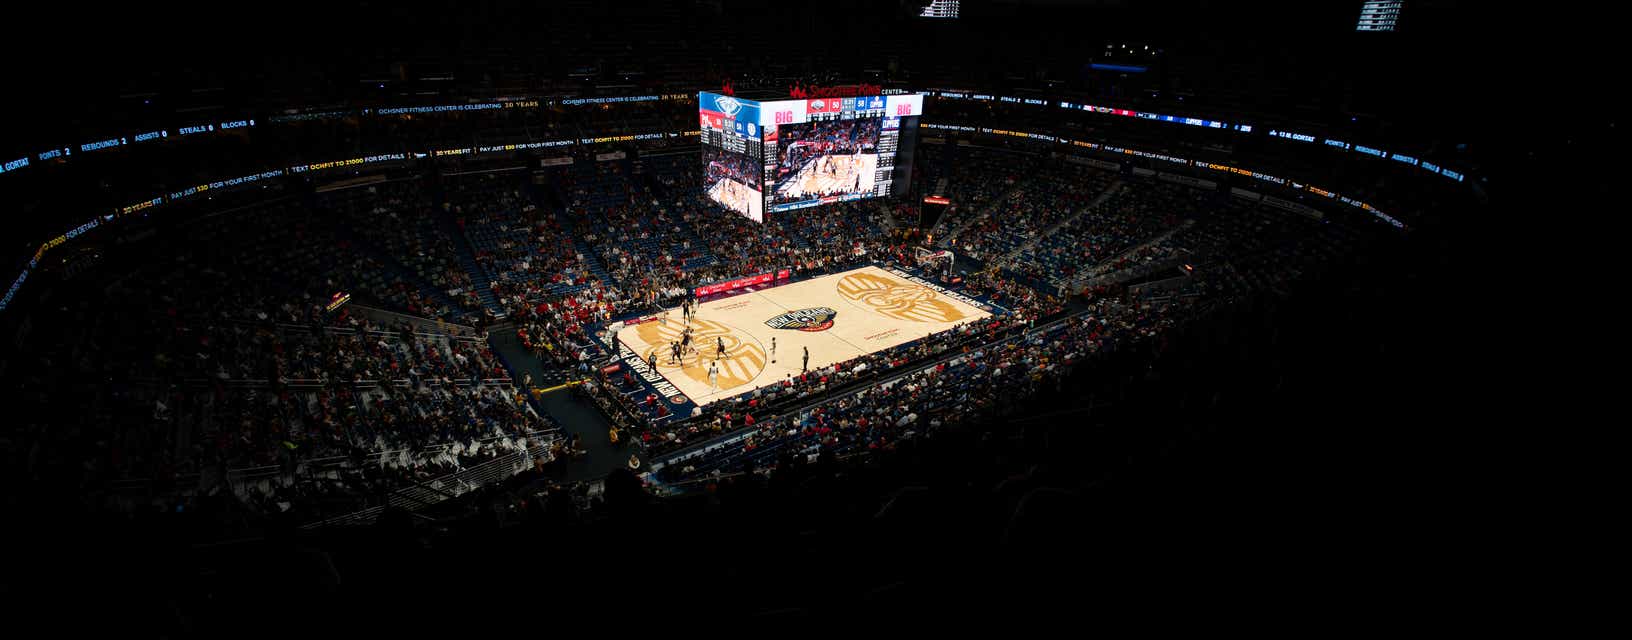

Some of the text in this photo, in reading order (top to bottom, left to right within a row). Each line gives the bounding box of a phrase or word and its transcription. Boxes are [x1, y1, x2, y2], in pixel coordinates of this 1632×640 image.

[897, 104, 912, 114] BIG
[775, 111, 792, 124] BIG
[39, 150, 61, 160] POINTS
[81, 139, 119, 152] REBOUNDS
[135, 132, 160, 142] ASSISTS
[179, 126, 206, 135] STEALS
[221, 120, 247, 129] BLOCKS
[4, 157, 29, 171] GORTAT
[224, 178, 243, 187] YOUR
[244, 174, 260, 183] FIRST
[261, 170, 282, 179] MONTH
[1264, 174, 1285, 184] DETAILS
[66, 229, 78, 239] FOR
[78, 220, 99, 234] DETAILS
